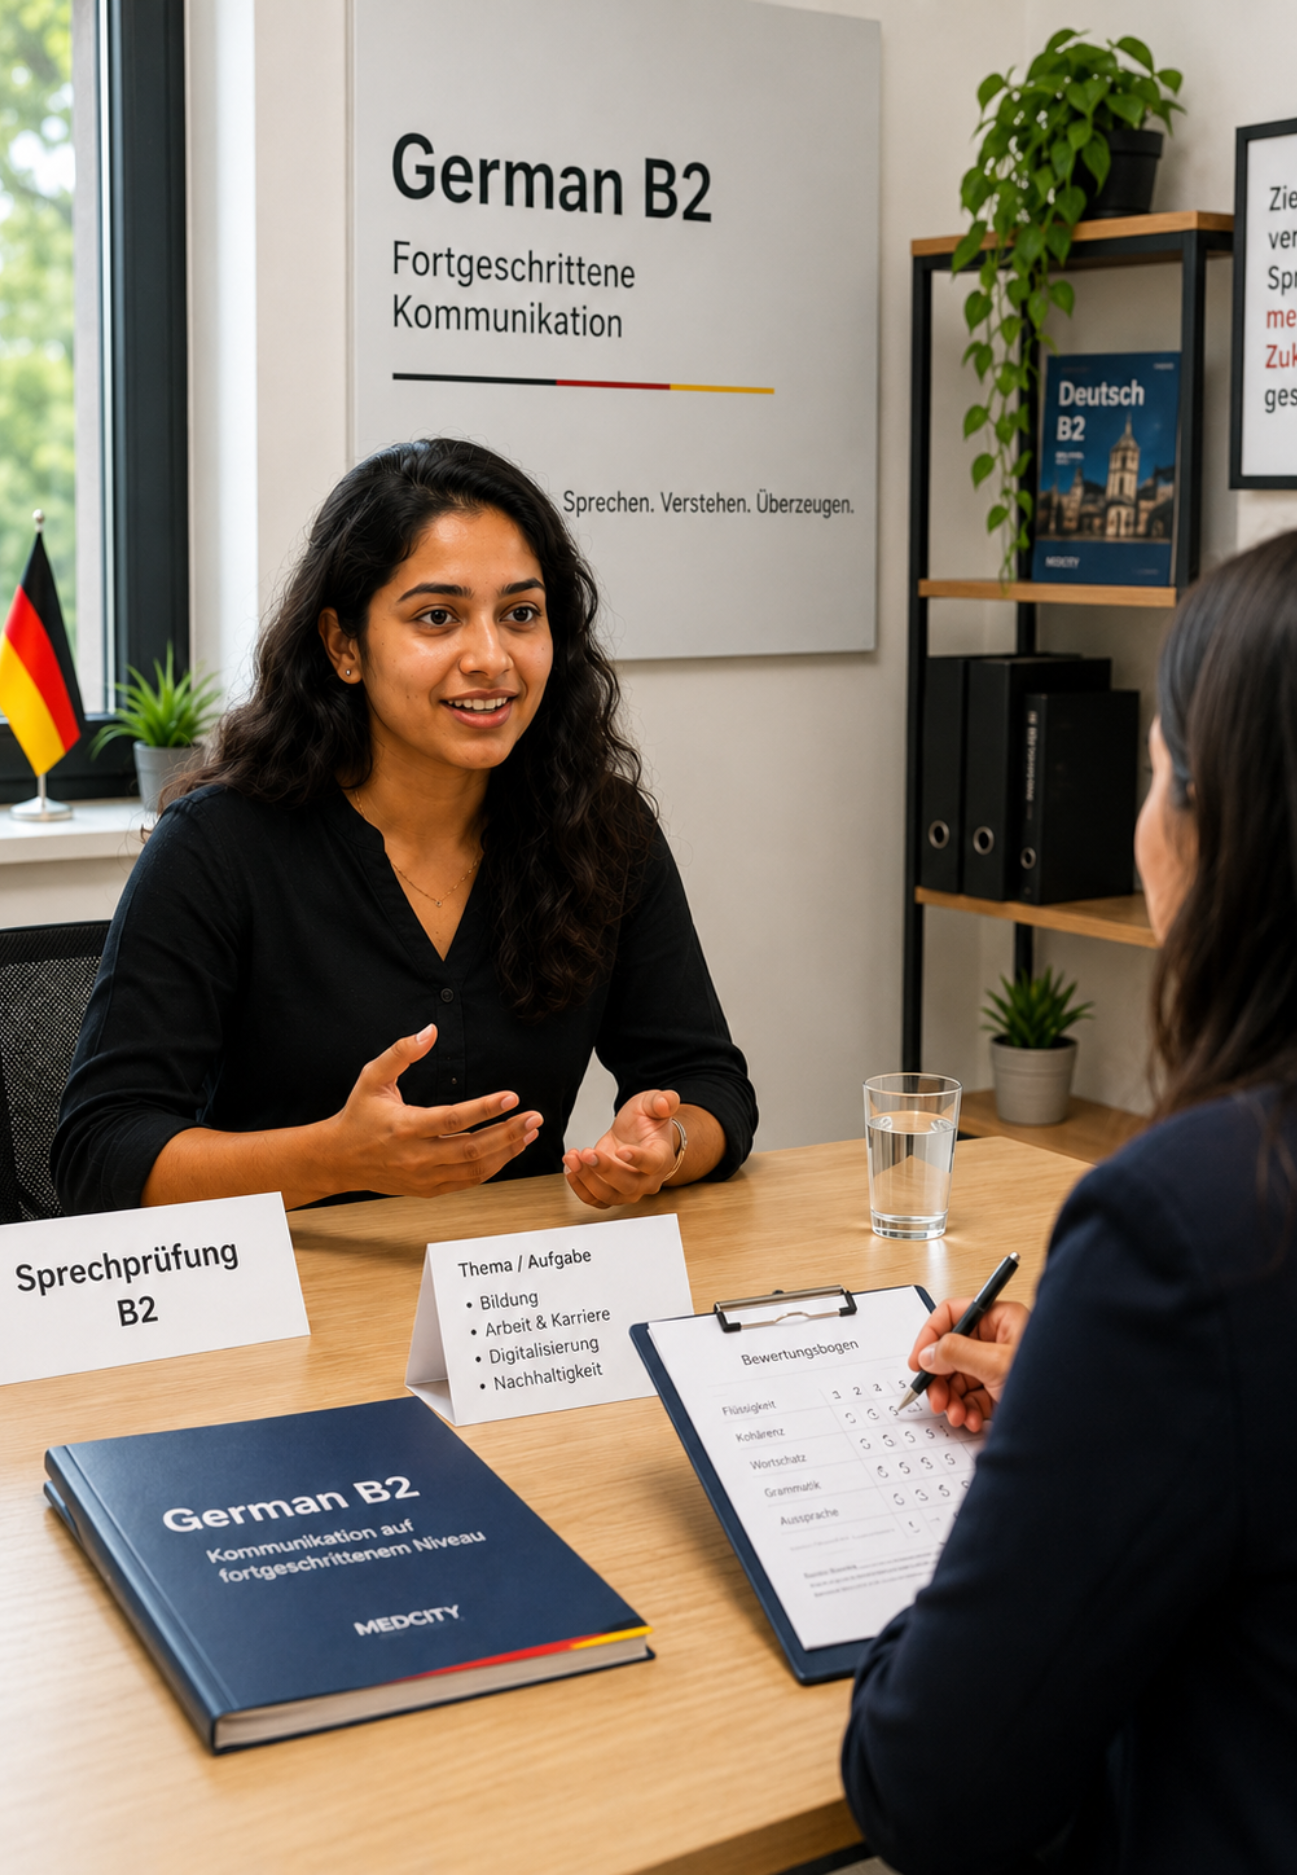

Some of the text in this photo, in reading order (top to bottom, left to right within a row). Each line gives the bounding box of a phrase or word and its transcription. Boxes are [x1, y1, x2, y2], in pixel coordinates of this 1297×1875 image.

[392, 131, 713, 223] German B2
[392, 240, 636, 288] Fortgeschrittene
[392, 294, 623, 338] Kommunikation
[1058, 379, 1145, 407] Deutsch
[1056, 415, 1086, 442] B2
[563, 488, 855, 519] Sprechen. Verstehen. Überzeugen.
[15, 1243, 239, 1297] Sprechprüfung
[457, 1249, 592, 1278] Thema / Aufgabe
[117, 1295, 159, 1327] B2
[480, 1292, 539, 1310] Bildung
[485, 1308, 611, 1337] Arbeit & Karriere
[489, 1337, 600, 1366] Digitalisierung
[741, 1339, 860, 1366] Bewertungsbogen
[493, 1362, 604, 1391] Nachhaltigkeit
[722, 1400, 777, 1417] Flüssigkeit
[735, 1427, 786, 1444] Kohärenz
[750, 1453, 808, 1471] Wortschatz
[162, 1475, 421, 1533] German B2
[780, 1506, 839, 1527] Aussprache
[206, 1518, 415, 1564] Kommunikation auf
[218, 1529, 487, 1583] fortgeschrittenem Niveau
[353, 1603, 460, 1637] MEDCITY
